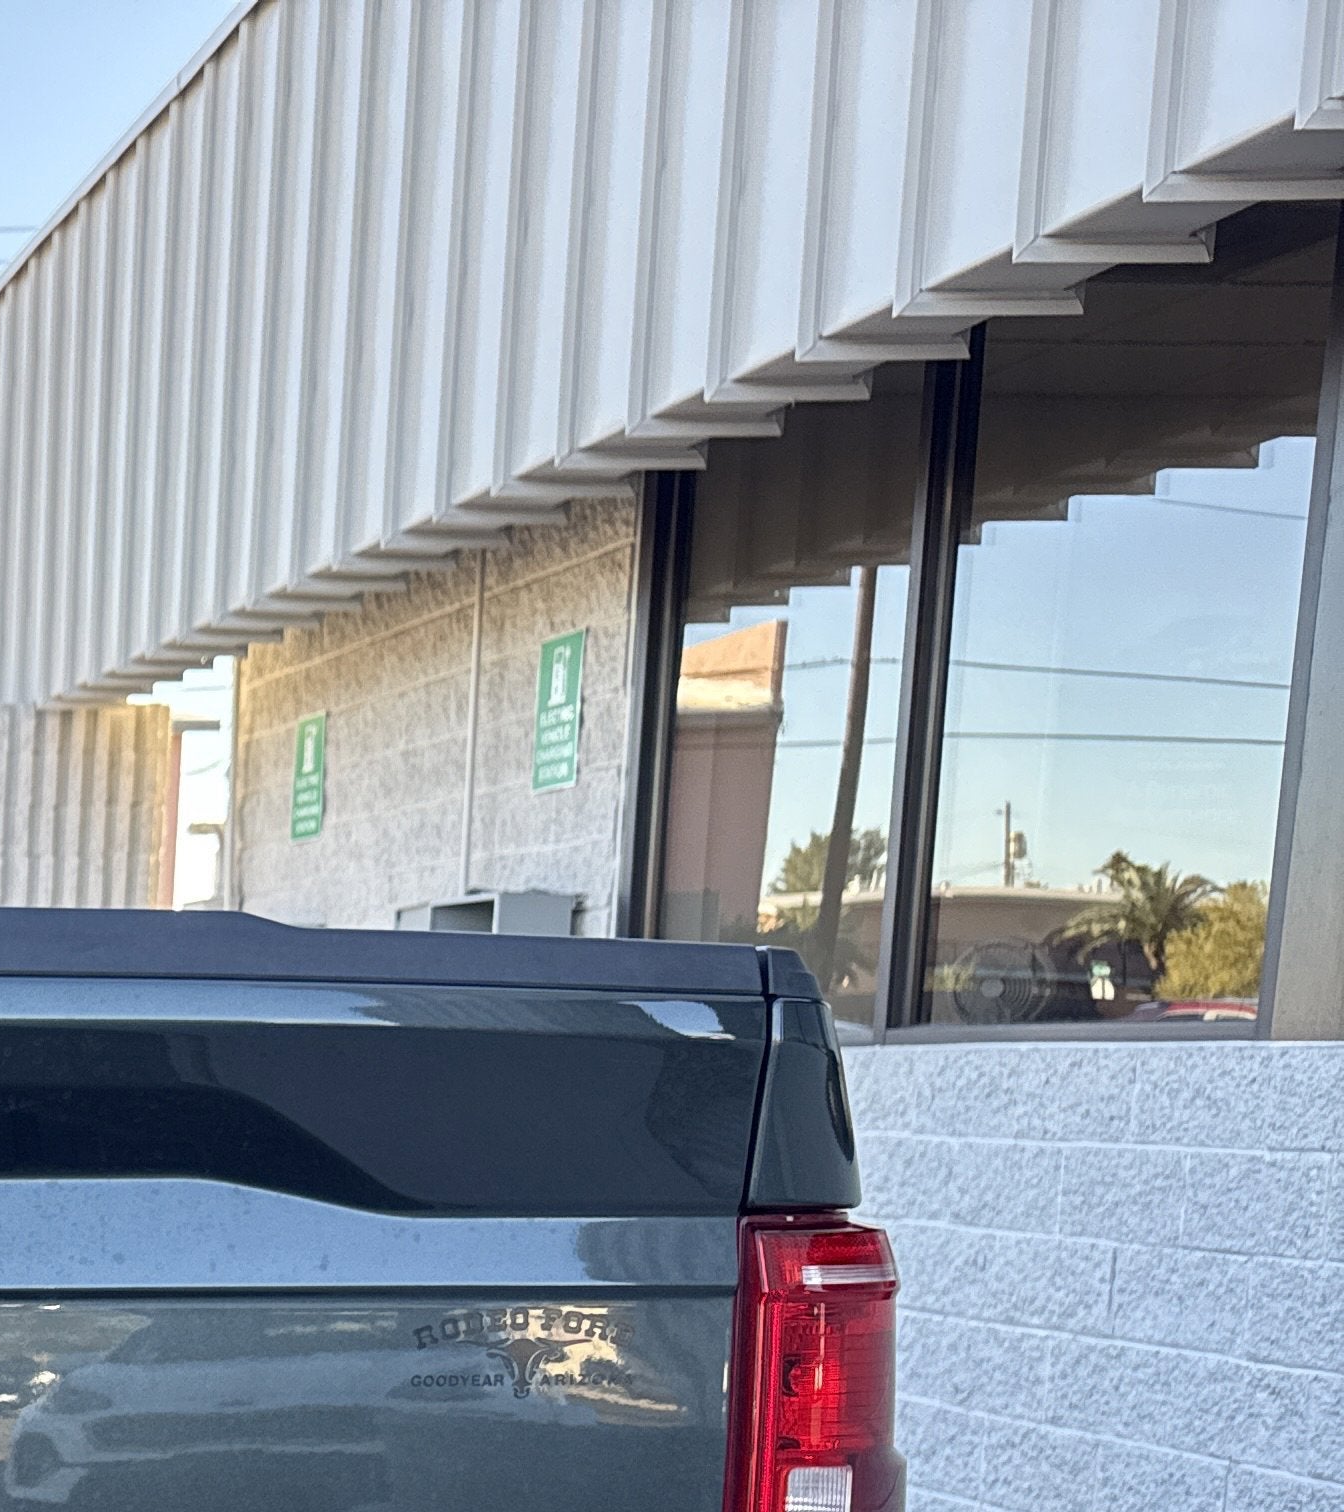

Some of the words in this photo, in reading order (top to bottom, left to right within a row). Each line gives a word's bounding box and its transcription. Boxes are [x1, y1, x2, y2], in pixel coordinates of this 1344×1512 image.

[413, 1307, 529, 1351] RODEO
[540, 1308, 635, 1347] FORD
[410, 1374, 505, 1387] GOODYEAR
